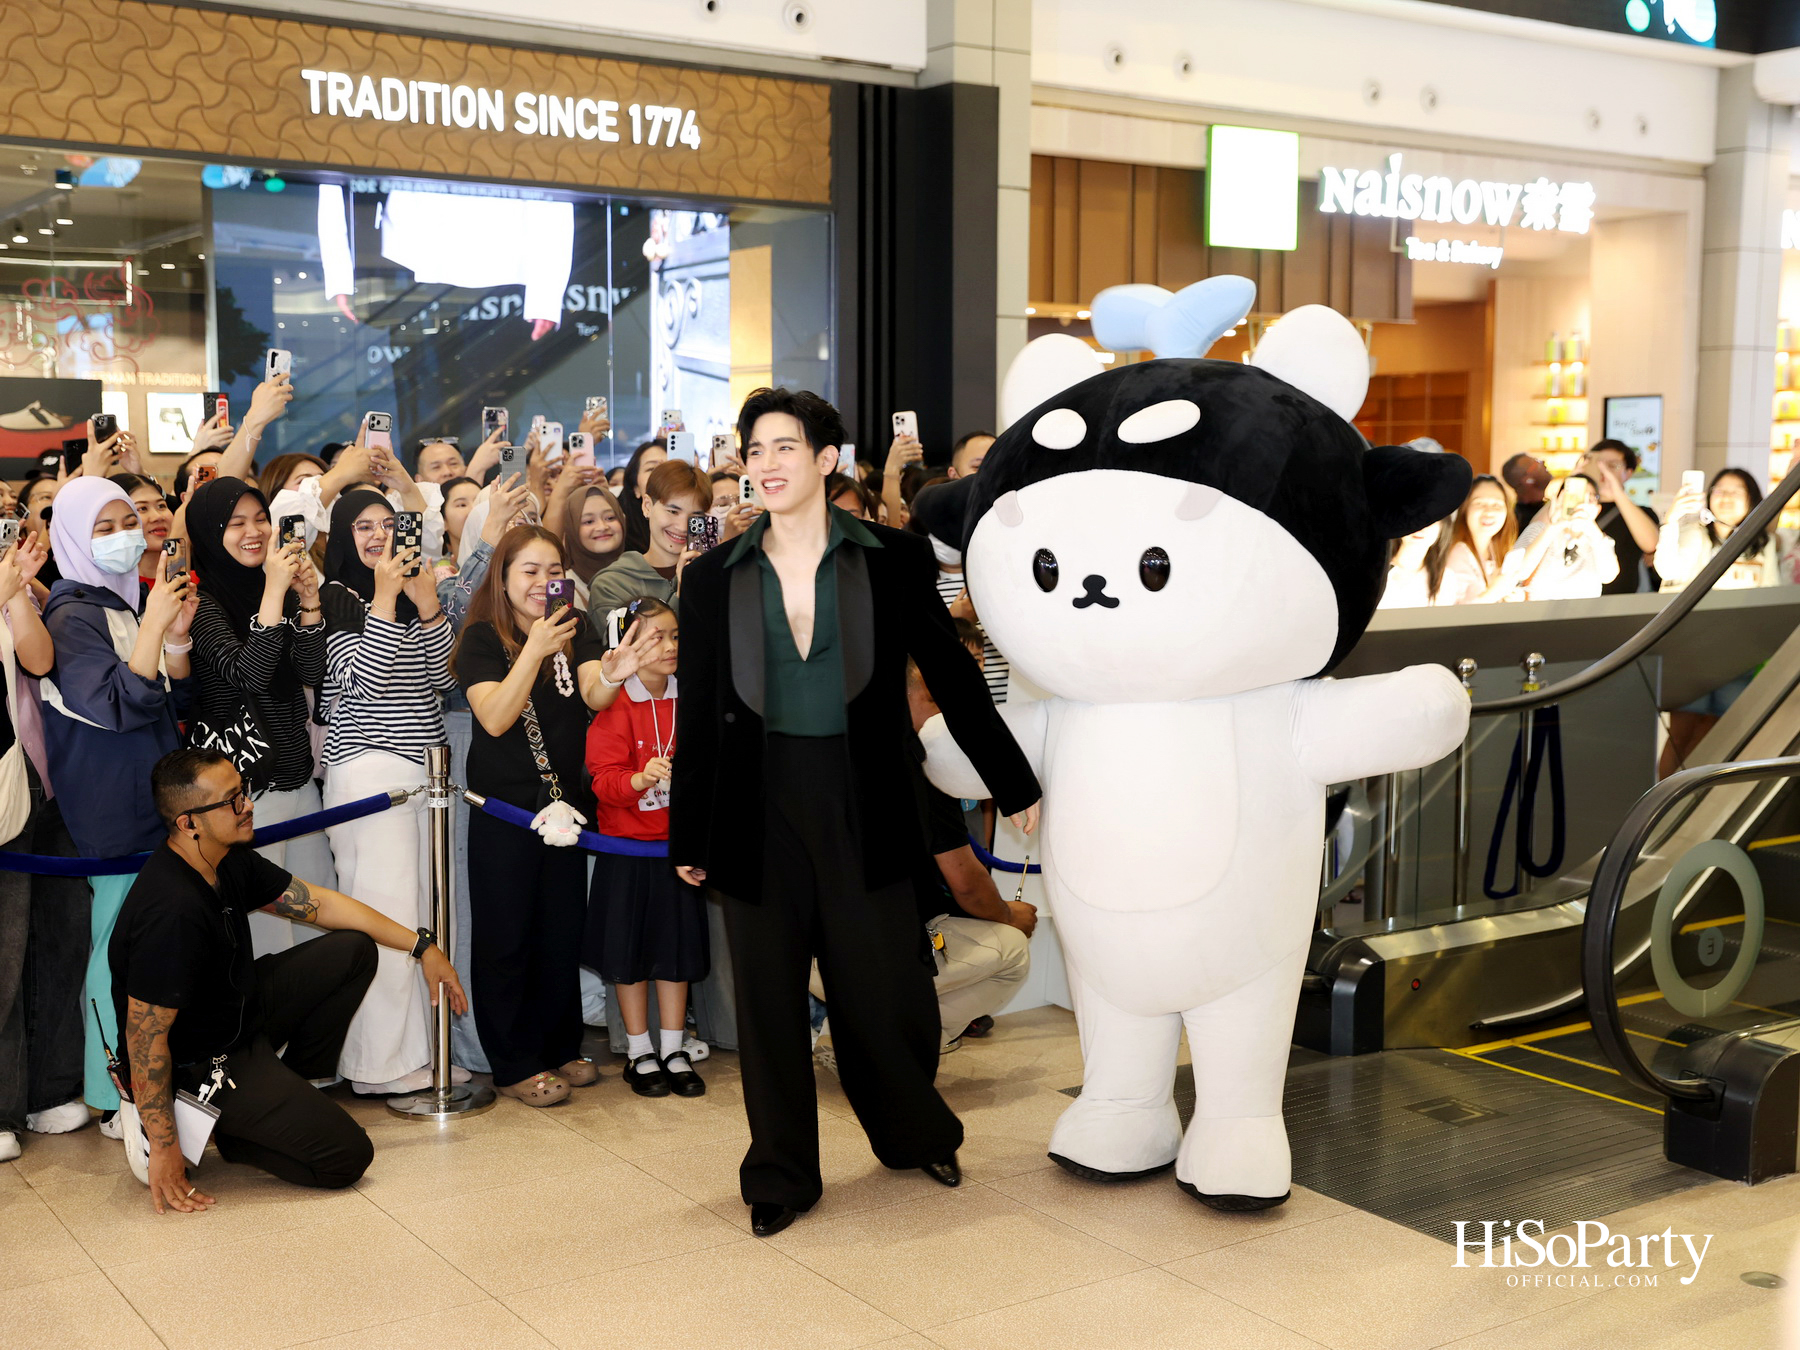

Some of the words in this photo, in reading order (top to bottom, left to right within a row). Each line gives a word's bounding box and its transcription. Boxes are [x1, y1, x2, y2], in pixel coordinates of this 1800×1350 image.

[301, 69, 505, 132] TRADITION
[514, 91, 620, 142] SINCE
[628, 103, 701, 150] 1774
